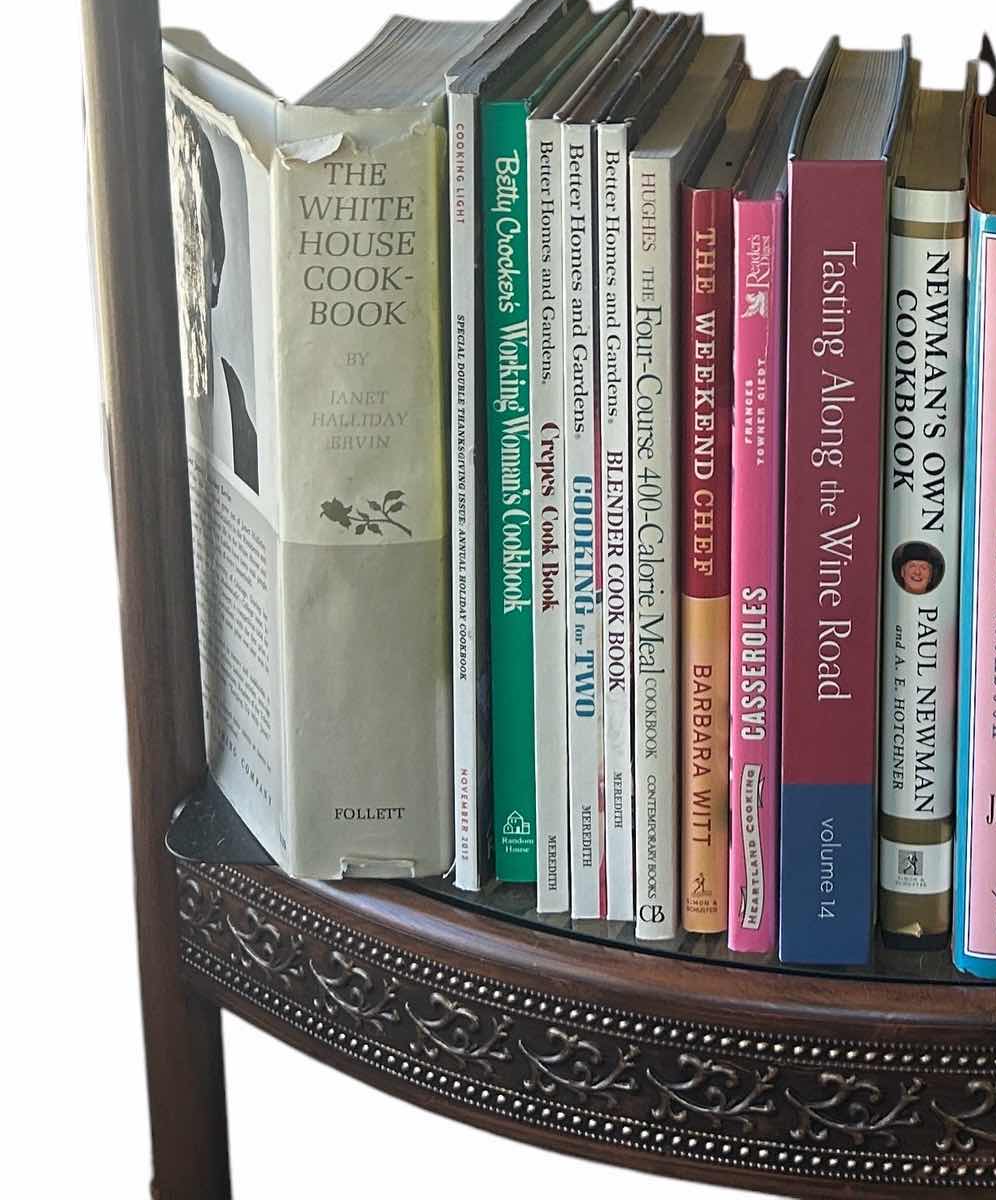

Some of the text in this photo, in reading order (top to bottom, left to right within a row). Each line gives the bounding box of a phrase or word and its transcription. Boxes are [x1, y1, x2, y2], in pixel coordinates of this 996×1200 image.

[298, 195, 413, 221] WHITE
[298, 232, 415, 255] HOUSE
[324, 162, 386, 186] THE
[455, 124, 465, 224] COOKING LIGHT
[641, 173, 655, 252] HUGHES
[303, 267, 413, 291] COOK-
[309, 302, 406, 326] BOOK
[492, 150, 531, 614] Betty Crocker's Working Woman's Cookbook
[694, 228, 715, 576] THE WEEKEND CHEF
[893, 289, 918, 492] COOKBOOK
[921, 251, 950, 532] NEWMAN'S OWN
[456, 314, 468, 680] SPECIAL DOUBLE THANKSGIVING ISSUE: ANNUAL HOLIDAY COOKBOOK
[536, 422, 560, 612] Crepes Cook Book
[635, 267, 665, 759] THE Four-Course 400-Calorie Meal COOKBOOK
[811, 242, 860, 701] Tasting Along the Wine Road
[573, 476, 595, 717] COOKING for TWO
[606, 450, 625, 691] BLENDER COOK BOOK
[741, 586, 767, 740] CASSEROLES
[335, 808, 404, 820] FOLLETT
[646, 775, 657, 899] CONTEMPORARY BOOKS
[693, 664, 712, 846] BARBARA WITT
[818, 818, 841, 918] volume 14
